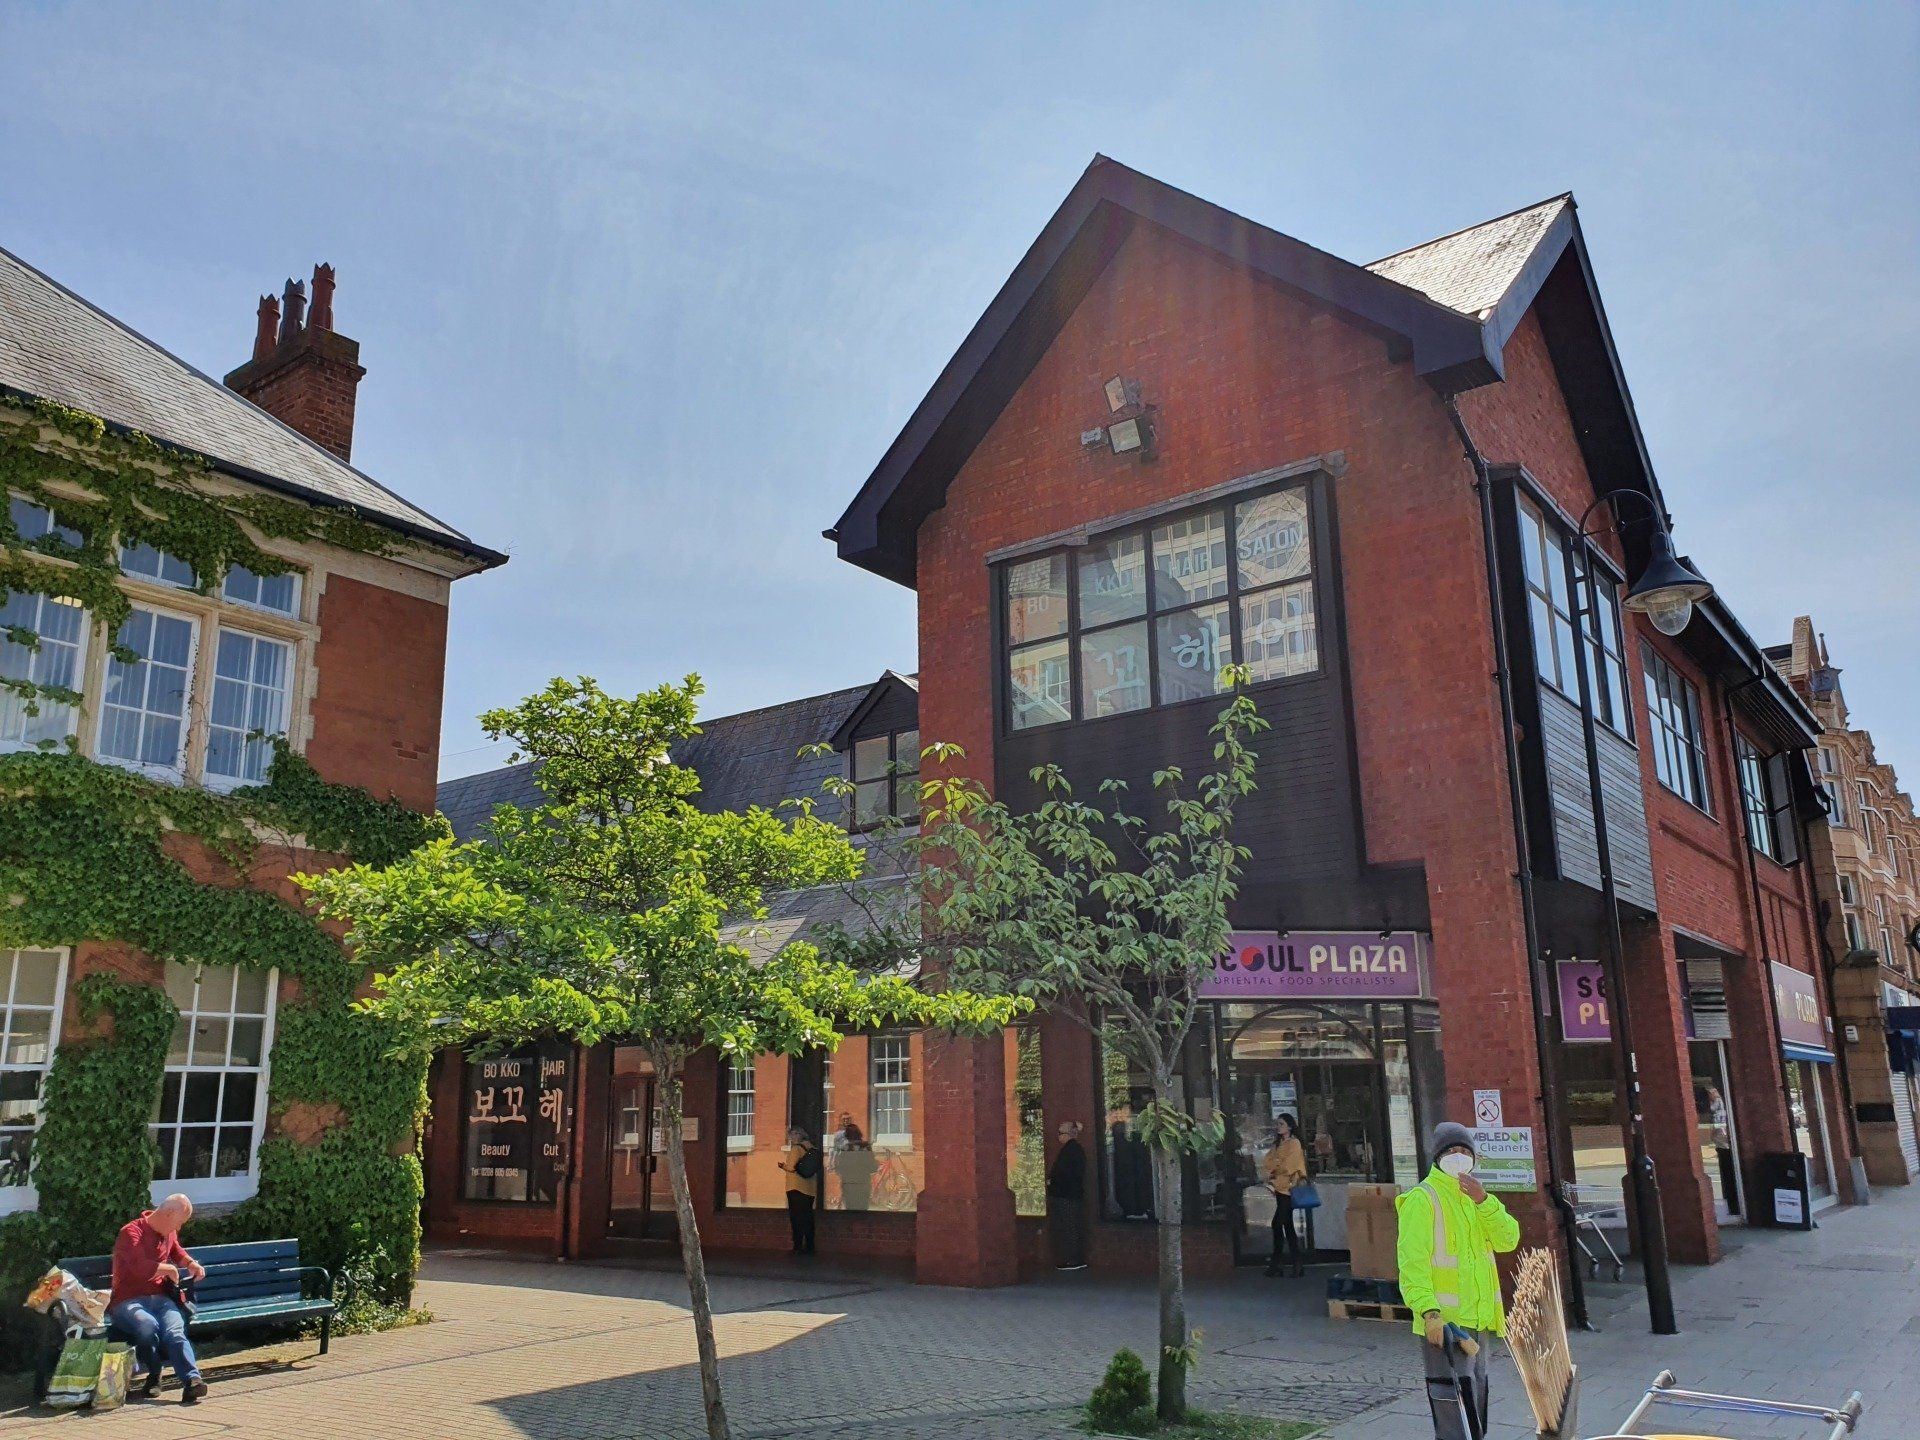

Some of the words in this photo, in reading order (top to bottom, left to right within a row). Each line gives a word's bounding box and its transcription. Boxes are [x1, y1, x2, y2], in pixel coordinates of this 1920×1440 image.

[1027, 596, 1049, 615] BO
[1167, 551, 1210, 580] HAIR
[1237, 523, 1304, 560] SALON
[1309, 944, 1407, 972] PLAZA
[1214, 976, 1272, 985] ORIENTAL
[1280, 976, 1313, 985] FOOD
[1320, 976, 1395, 985] SPECIALISTS
[1576, 976, 1607, 998] SE
[1579, 1002, 1609, 1025] PL
[483, 1063, 497, 1078] BO
[500, 1062, 520, 1077] KKO
[541, 1060, 565, 1077] HAIR
[1472, 1131, 1528, 1143] MBLEDON
[481, 1144, 511, 1156] Beauty
[543, 1143, 559, 1156] Cut
[1480, 1142, 1530, 1153] Cleaners
